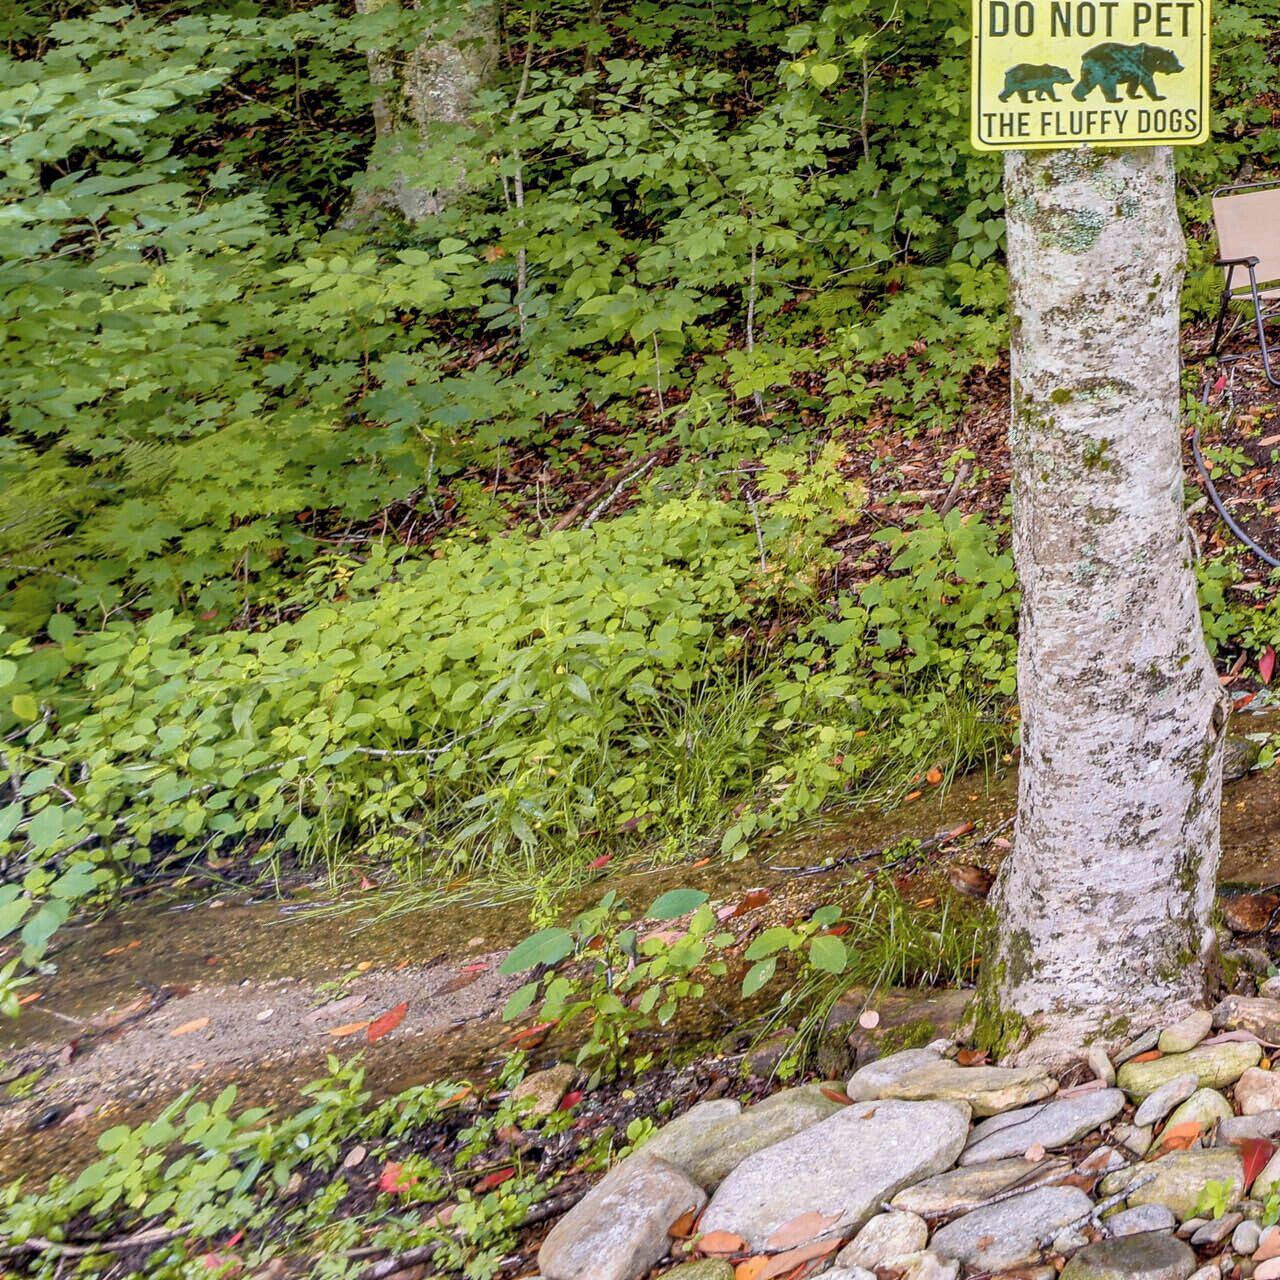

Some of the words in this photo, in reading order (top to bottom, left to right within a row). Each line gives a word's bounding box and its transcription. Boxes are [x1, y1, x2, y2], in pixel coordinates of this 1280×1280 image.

[989, 0, 1035, 37] DO
[1050, 1, 1119, 37] NOT
[1133, 2, 1195, 37] PET
[983, 112, 1030, 137] THE
[1040, 109, 1128, 136] FLUFFY
[1138, 108, 1198, 133] DOGS
